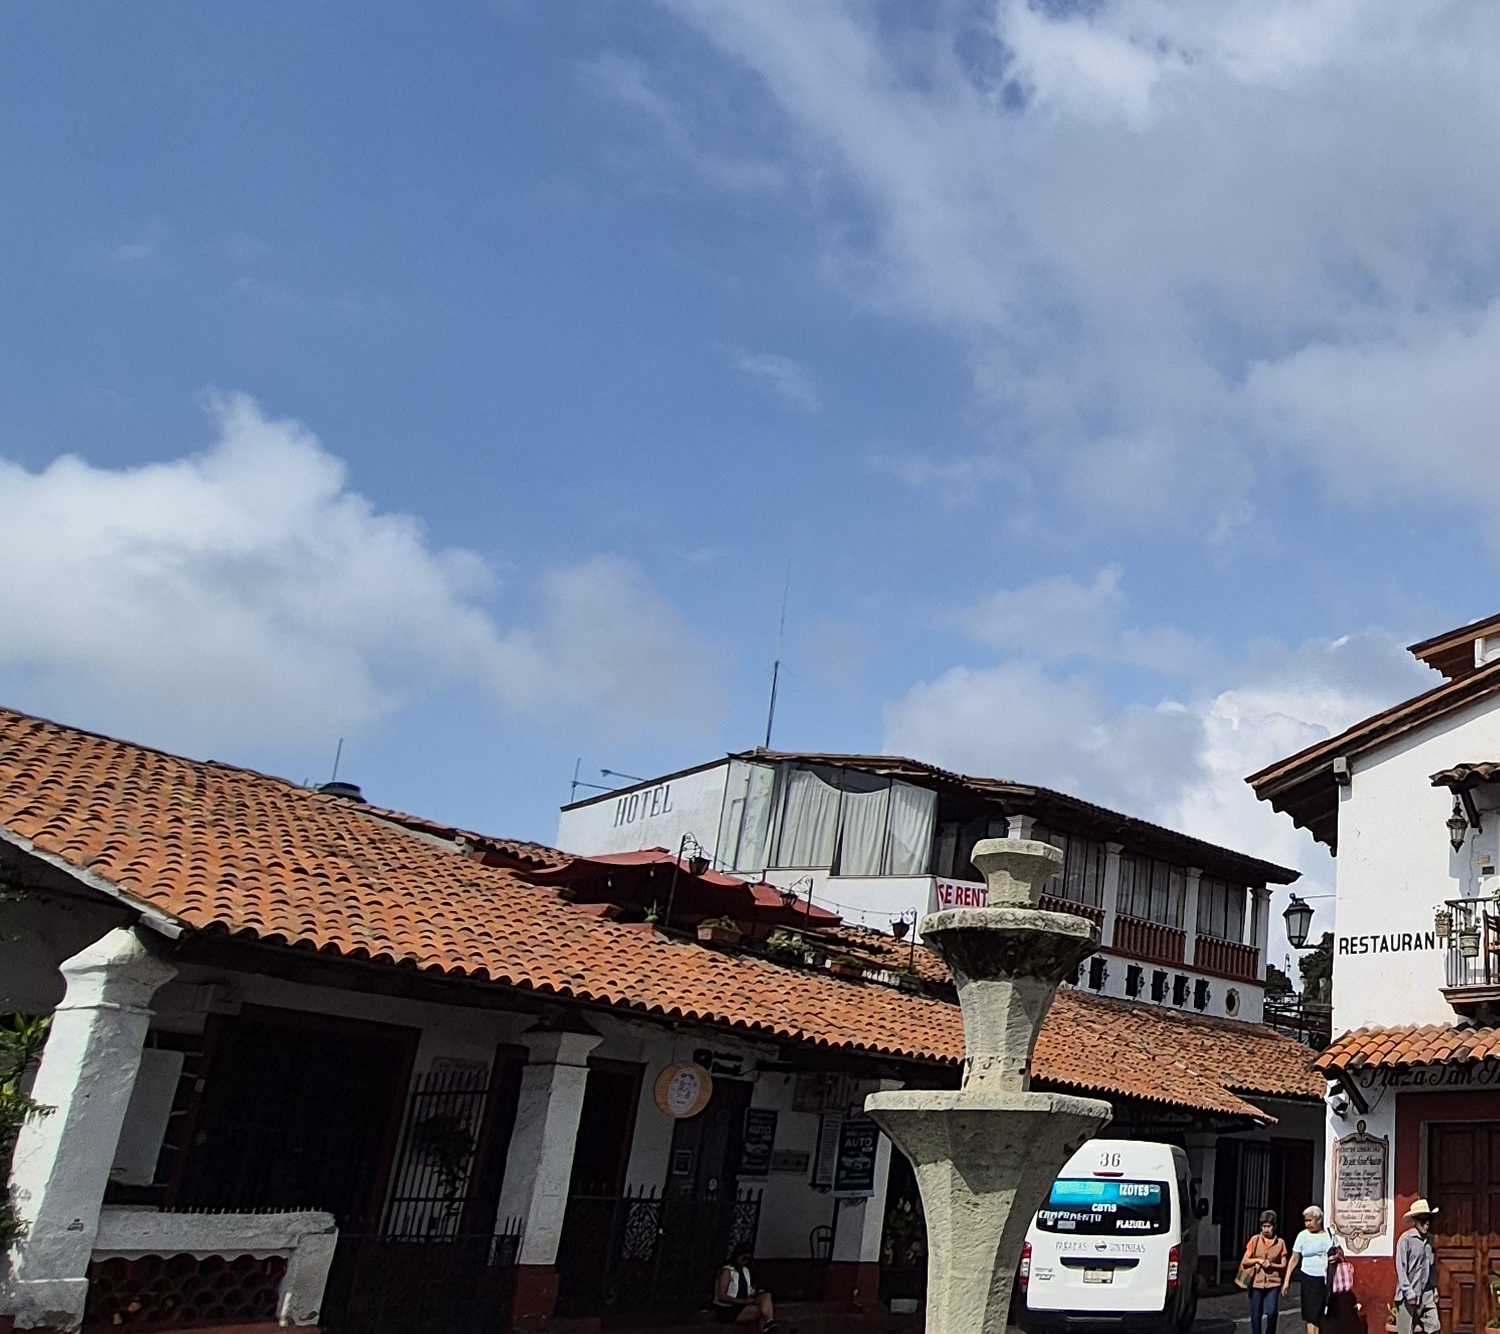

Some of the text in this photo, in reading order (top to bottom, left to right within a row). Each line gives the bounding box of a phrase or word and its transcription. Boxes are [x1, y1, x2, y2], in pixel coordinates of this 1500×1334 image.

[614, 784, 673, 828] HOTEL
[938, 883, 953, 904] SE
[1360, 1067, 1427, 1088] Plaza
[844, 1137, 873, 1148] AUTO
[1100, 1152, 1122, 1168] 36
[1119, 1184, 1149, 1196] IZOTES
[1116, 1219, 1151, 1229] PLAZUELA
